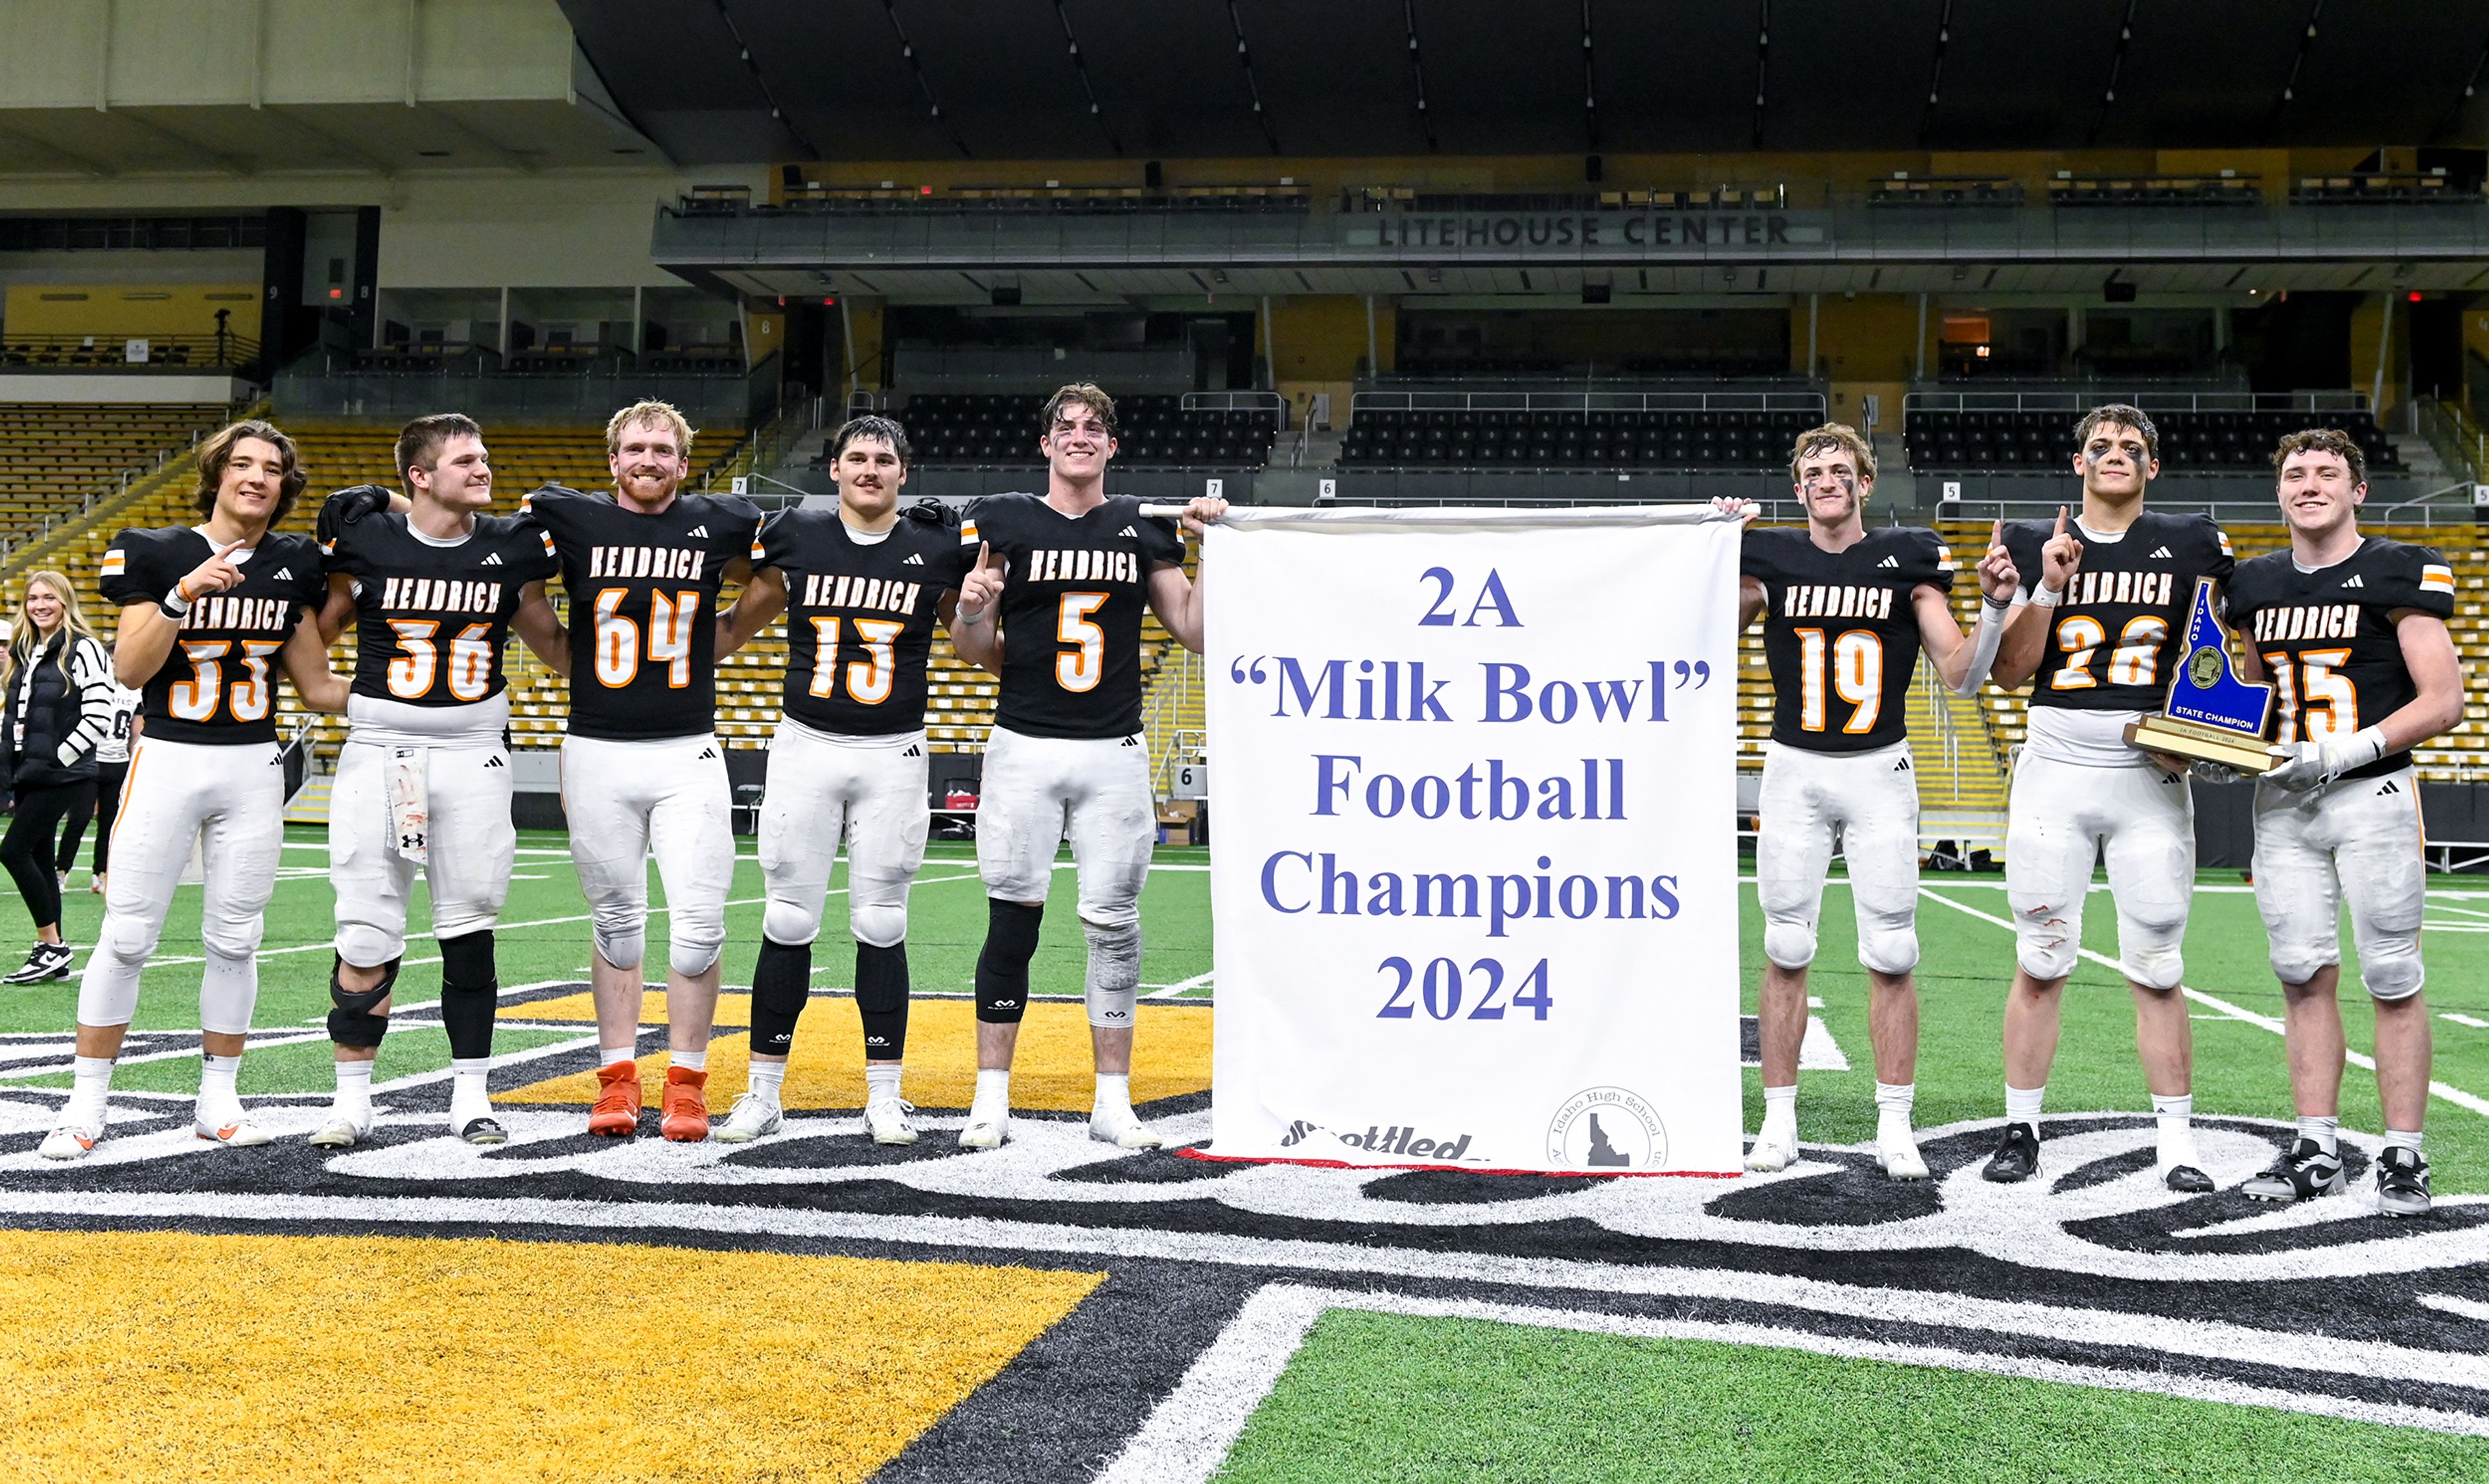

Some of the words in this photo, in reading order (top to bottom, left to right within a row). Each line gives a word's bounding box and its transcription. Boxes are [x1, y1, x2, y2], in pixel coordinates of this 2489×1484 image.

[1379, 216, 1599, 247] LITEHOUSE
[1624, 216, 1790, 246] CENTER
[270, 285, 278, 299] 9
[761, 319, 771, 334] 8
[736, 480, 743, 491] 7
[1211, 483, 1218, 494] 7
[1324, 483, 1331, 494] 6
[1948, 486, 1956, 498] 5
[2481, 489, 2488, 501] 5
[589, 546, 706, 581] KENDRICK
[1027, 550, 1138, 583] KENDRICK
[380, 577, 502, 614] KENDRICK
[802, 574, 922, 616] KENDRICK
[1418, 566, 1525, 627] 2A
[1784, 585, 1893, 620] KENDRICK
[593, 587, 700, 689] 64
[2190, 599, 2204, 642] IDAHO
[386, 618, 494, 702] 36
[809, 616, 906, 705] 13
[1055, 592, 1110, 693] 5
[2051, 615, 2169, 690] 28
[1230, 655, 1453, 722] “Milk
[1477, 660, 1710, 724] Bowl”
[1794, 627, 1883, 734] 19
[2262, 647, 2359, 745] 15
[2175, 706, 2204, 719] STATE
[2205, 712, 2254, 730] CHAMPION
[2189, 730, 2220, 741] FOOTBALL
[2221, 736, 2235, 744] 2024
[1180, 768, 1192, 785] 6
[1309, 754, 1628, 820] Football
[1261, 850, 1680, 937] Champions
[1375, 956, 1554, 1021] 2024
[1553, 1100, 1583, 1135] Idaho
[1586, 1091, 1621, 1102] High
[1625, 1096, 1661, 1137] School
